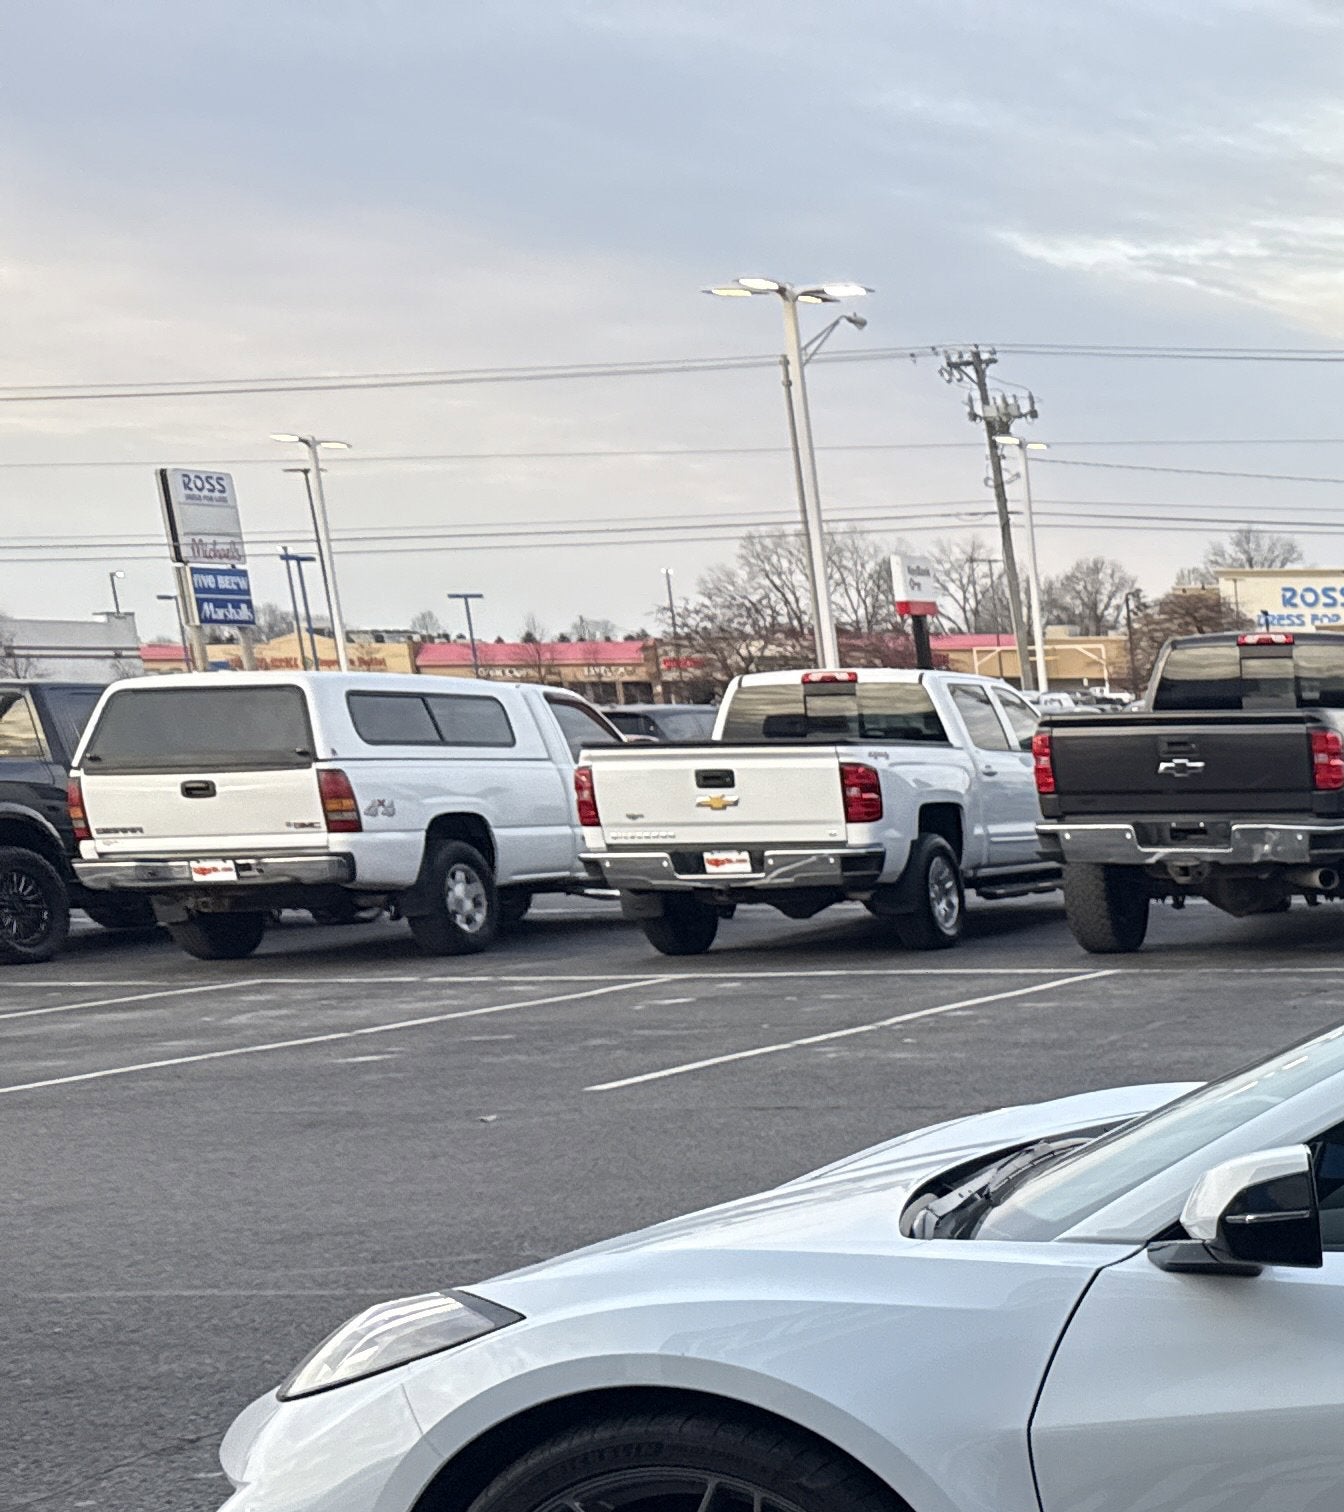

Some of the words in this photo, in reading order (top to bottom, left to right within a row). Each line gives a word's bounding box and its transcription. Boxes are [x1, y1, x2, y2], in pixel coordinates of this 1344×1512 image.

[182, 473, 227, 494] ROSS
[201, 601, 253, 621] Marshalls
[1257, 613, 1306, 627] DRESS
